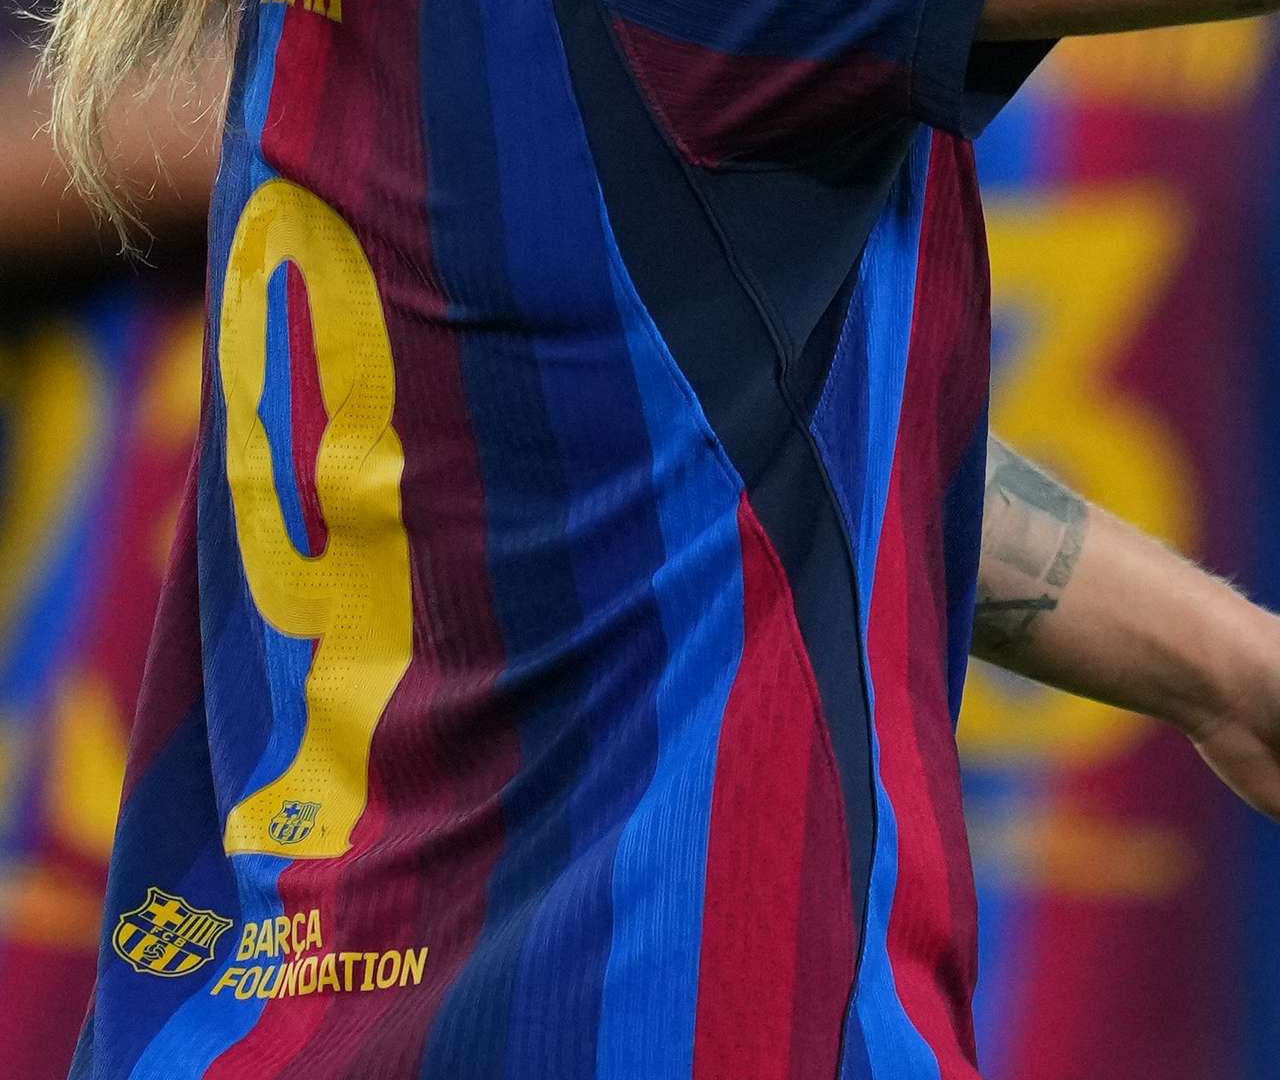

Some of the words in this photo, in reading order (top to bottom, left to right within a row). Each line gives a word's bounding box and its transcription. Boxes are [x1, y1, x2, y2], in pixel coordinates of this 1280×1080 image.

[218, 178, 413, 858] 9
[236, 909, 324, 961] BARÇA
[210, 947, 429, 1001] FOUNDATION
